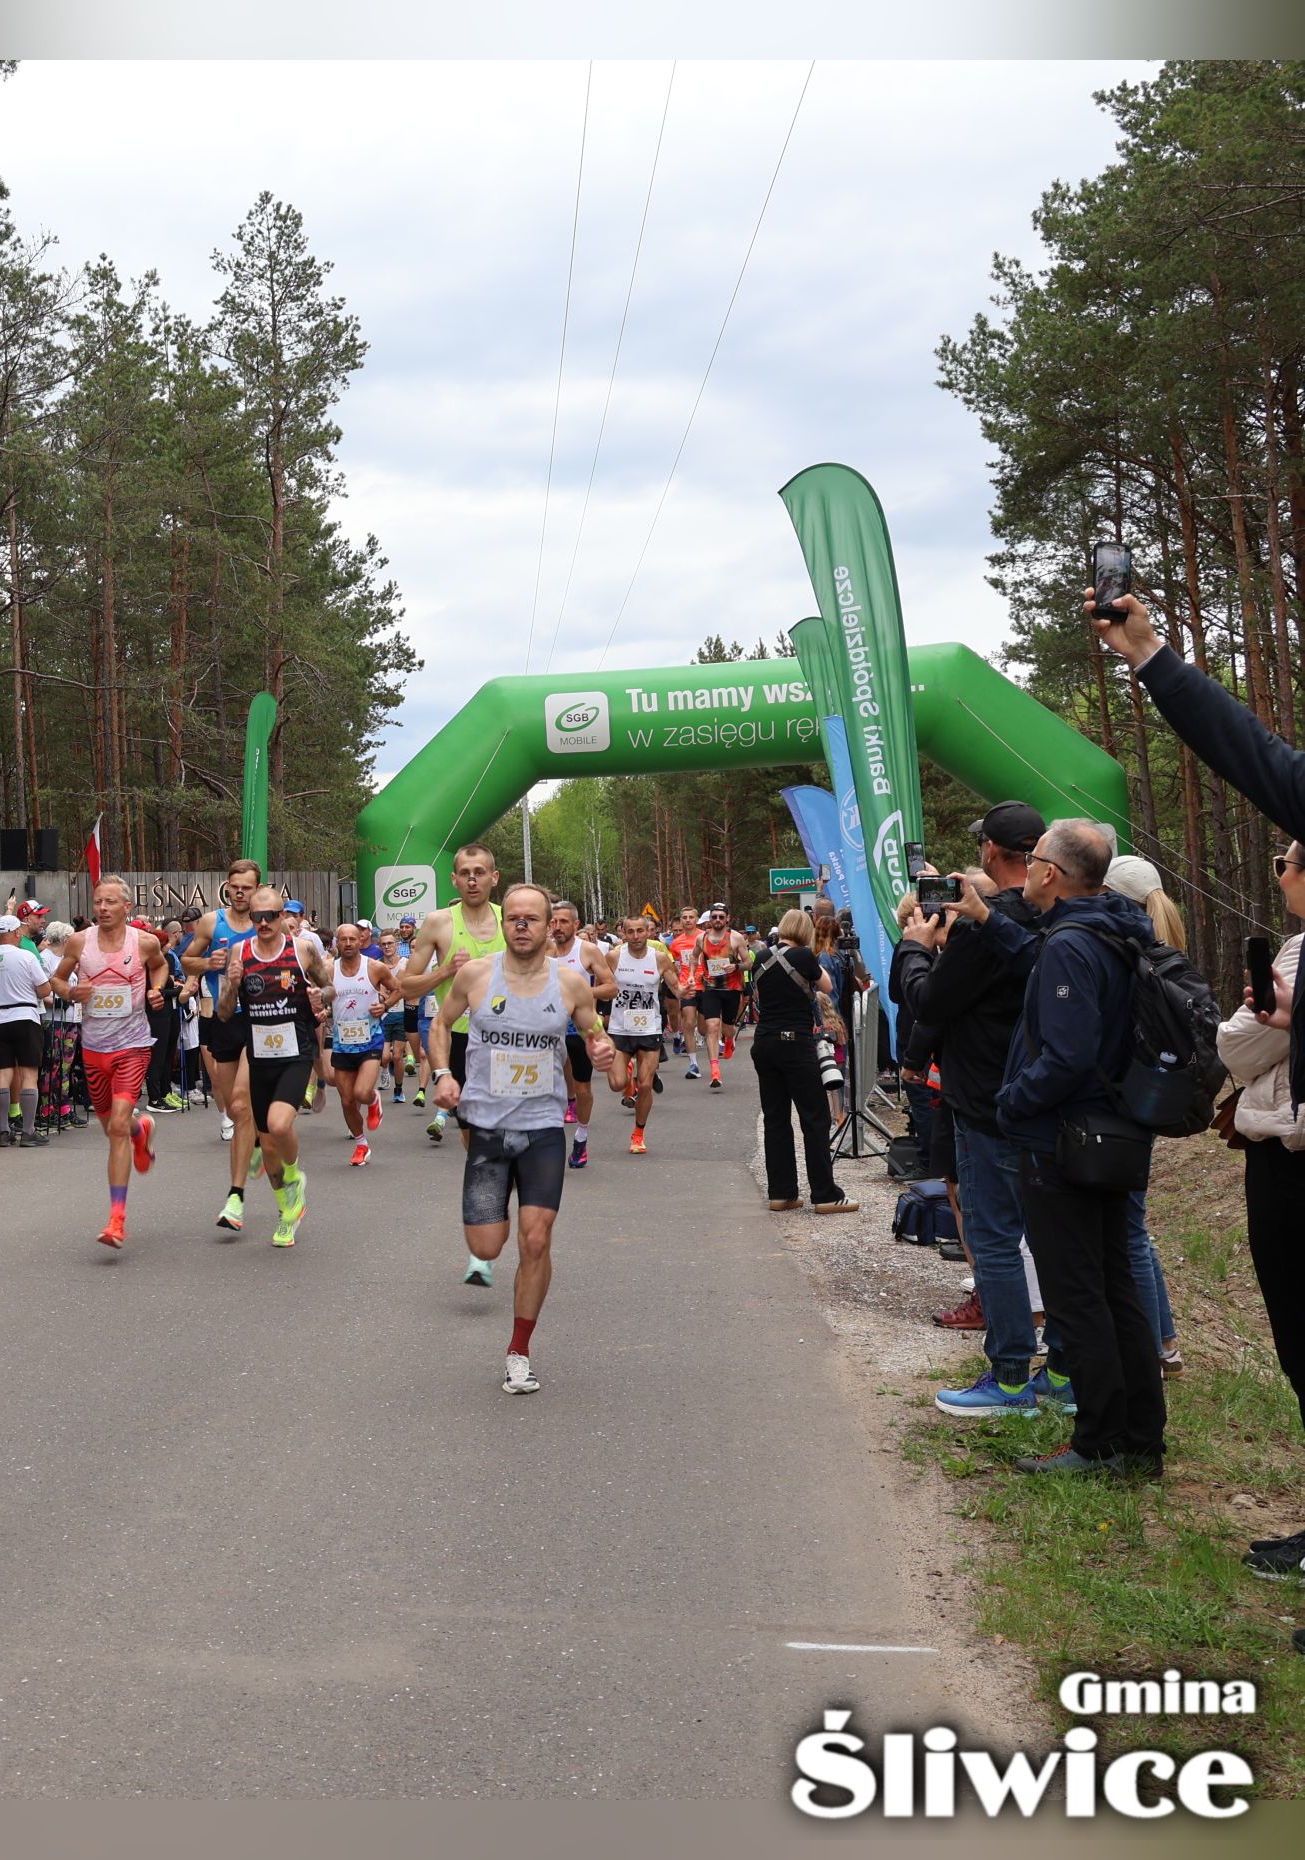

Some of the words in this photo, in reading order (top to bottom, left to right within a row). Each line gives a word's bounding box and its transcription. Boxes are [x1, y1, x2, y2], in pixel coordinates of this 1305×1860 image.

[625, 688, 658, 713] Tu
[667, 685, 754, 713] mamy
[566, 713, 589, 723] SGB
[559, 735, 598, 746] MOBILE
[627, 729, 654, 749] w
[663, 717, 776, 749] zasięgu
[134, 877, 209, 907] EŚNA
[393, 888, 417, 898] SGB
[93, 994, 125, 1009] 269
[633, 1015, 648, 1027] 93
[342, 1026, 366, 1038] 251
[263, 1034, 284, 1049] 49
[509, 1064, 539, 1085] 75
